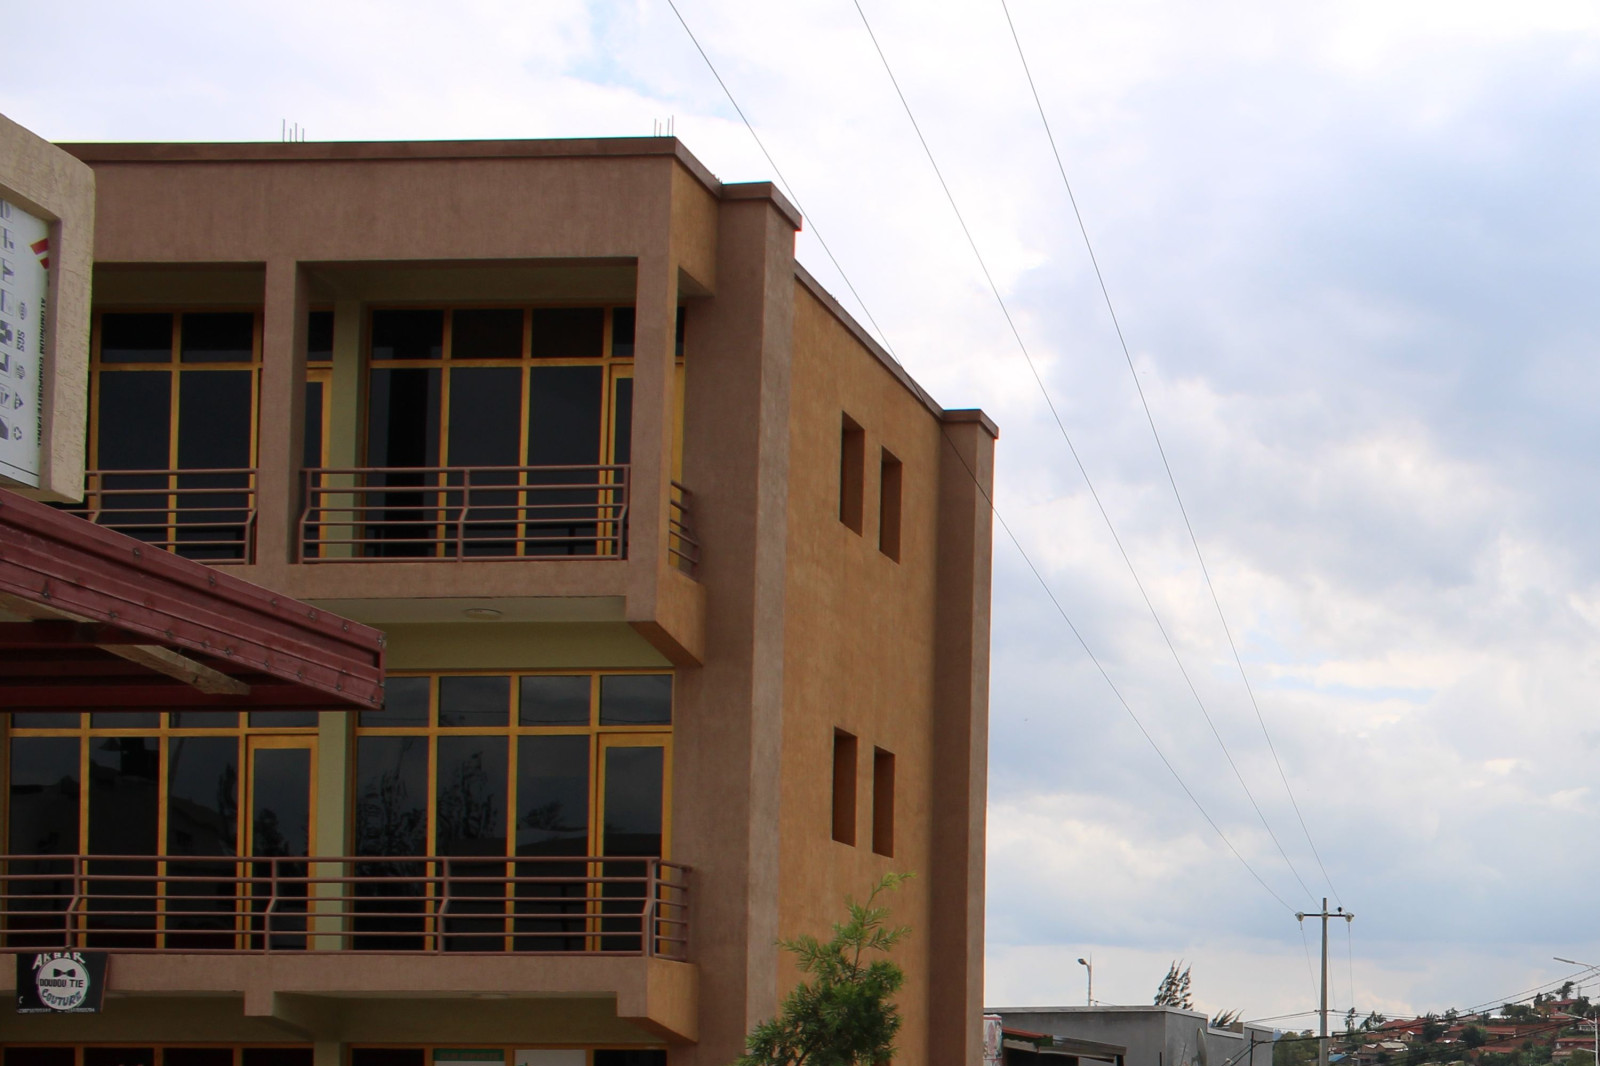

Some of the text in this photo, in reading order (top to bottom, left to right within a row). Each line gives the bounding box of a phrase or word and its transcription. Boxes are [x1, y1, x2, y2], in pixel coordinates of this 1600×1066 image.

[17, 329, 26, 352] SGS
[32, 952, 86, 970] AKBAR
[69, 979, 84, 988] TIE
[42, 988, 82, 1006] COUTURE
